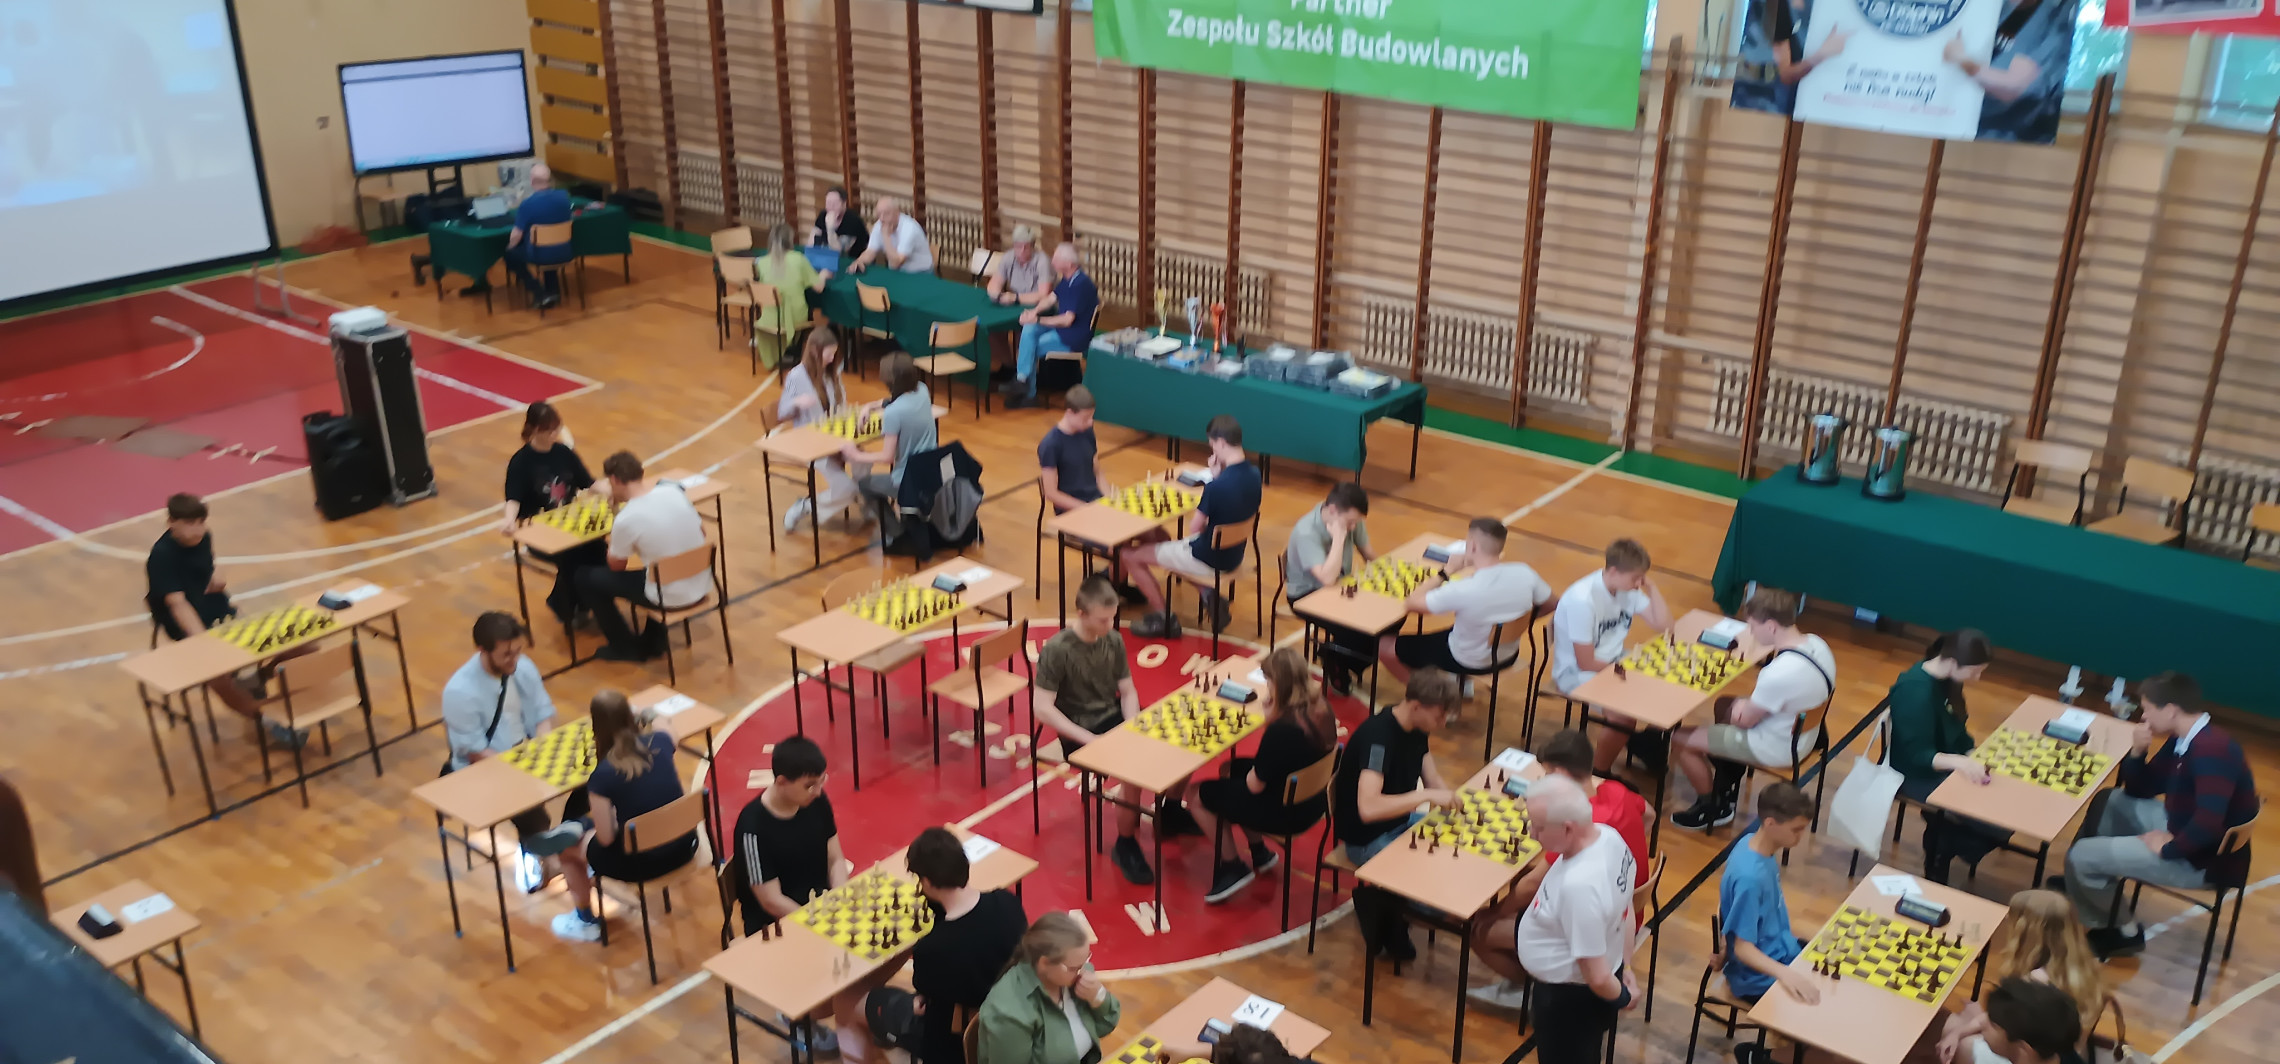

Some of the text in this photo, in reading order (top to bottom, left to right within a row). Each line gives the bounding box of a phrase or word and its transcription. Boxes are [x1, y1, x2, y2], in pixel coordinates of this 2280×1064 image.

[1167, 9, 1529, 81] Zespołu Szkół Budowlanych
